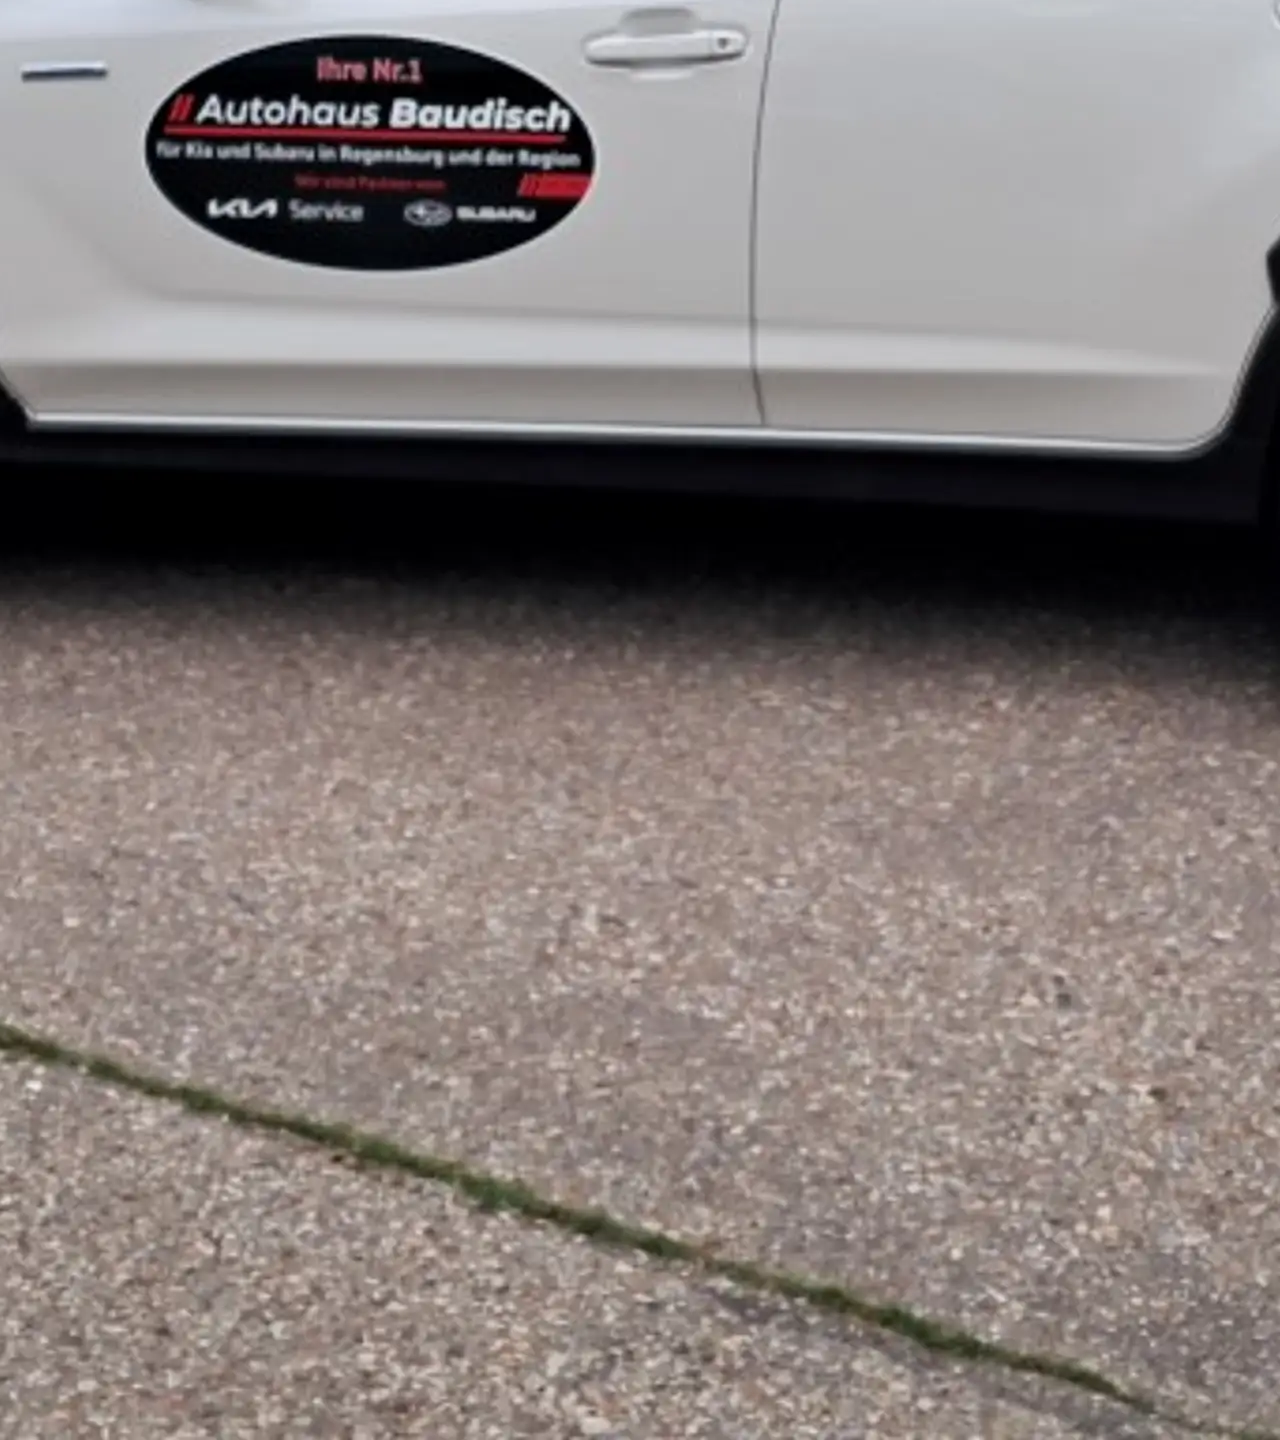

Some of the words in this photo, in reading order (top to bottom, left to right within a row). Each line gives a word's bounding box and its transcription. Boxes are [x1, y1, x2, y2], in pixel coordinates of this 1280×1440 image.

[317, 56, 367, 81] Ihre
[194, 93, 380, 127] Autohaus
[389, 96, 571, 131] Baudisch
[288, 198, 363, 222] Service
